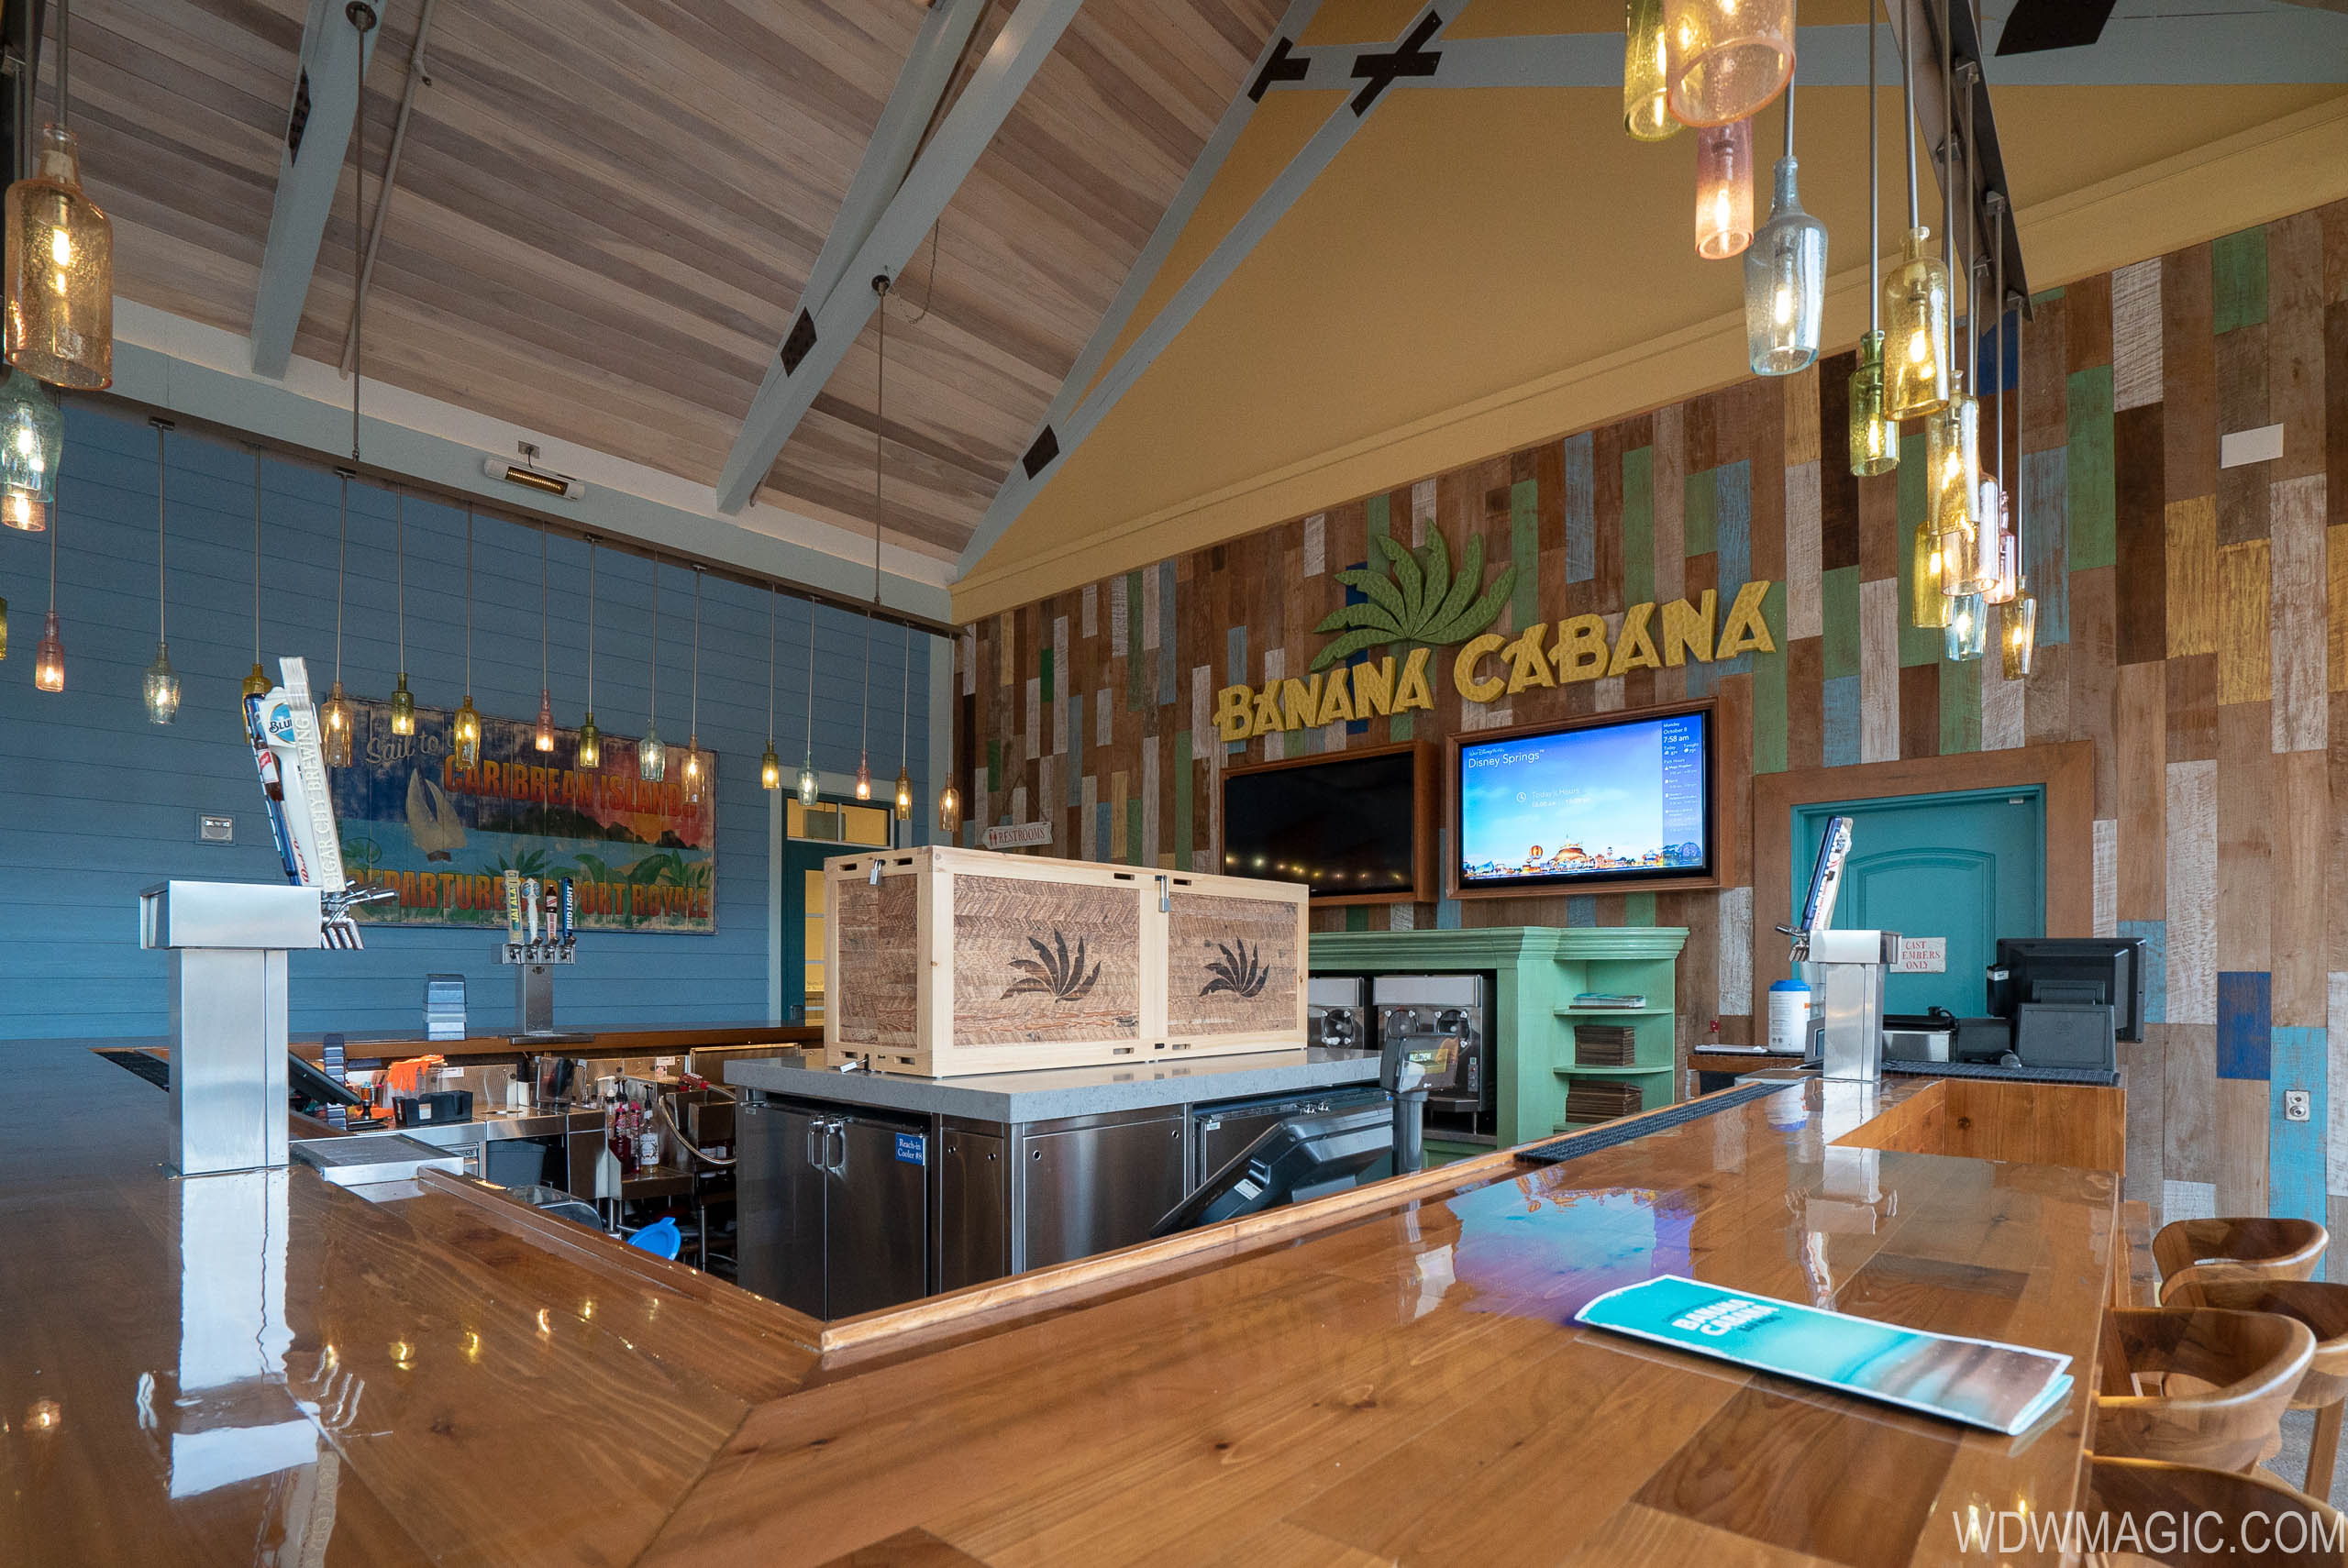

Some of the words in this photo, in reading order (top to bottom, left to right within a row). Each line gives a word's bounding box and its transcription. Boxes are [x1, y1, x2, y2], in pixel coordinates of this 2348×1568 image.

[1213, 647, 1434, 742] BANANA
[1453, 580, 1776, 703] CABANA
[295, 718, 324, 792] BREWING
[365, 734, 415, 763] Sail
[418, 730, 439, 754] to
[1468, 757, 1501, 768] Disney
[445, 755, 593, 808] CARIBBEAN
[310, 799, 331, 834] CITY
[998, 827, 1045, 844] RESTROOMS
[318, 840, 340, 890] CIGAR
[631, 883, 708, 918] ROYALE
[1901, 951, 1941, 959] EMBERS
[1906, 941, 1926, 949] CAST
[1906, 960, 1928, 969] ONLY
[898, 1148, 914, 1159] Cooler
[900, 1138, 921, 1151] Reach-in
